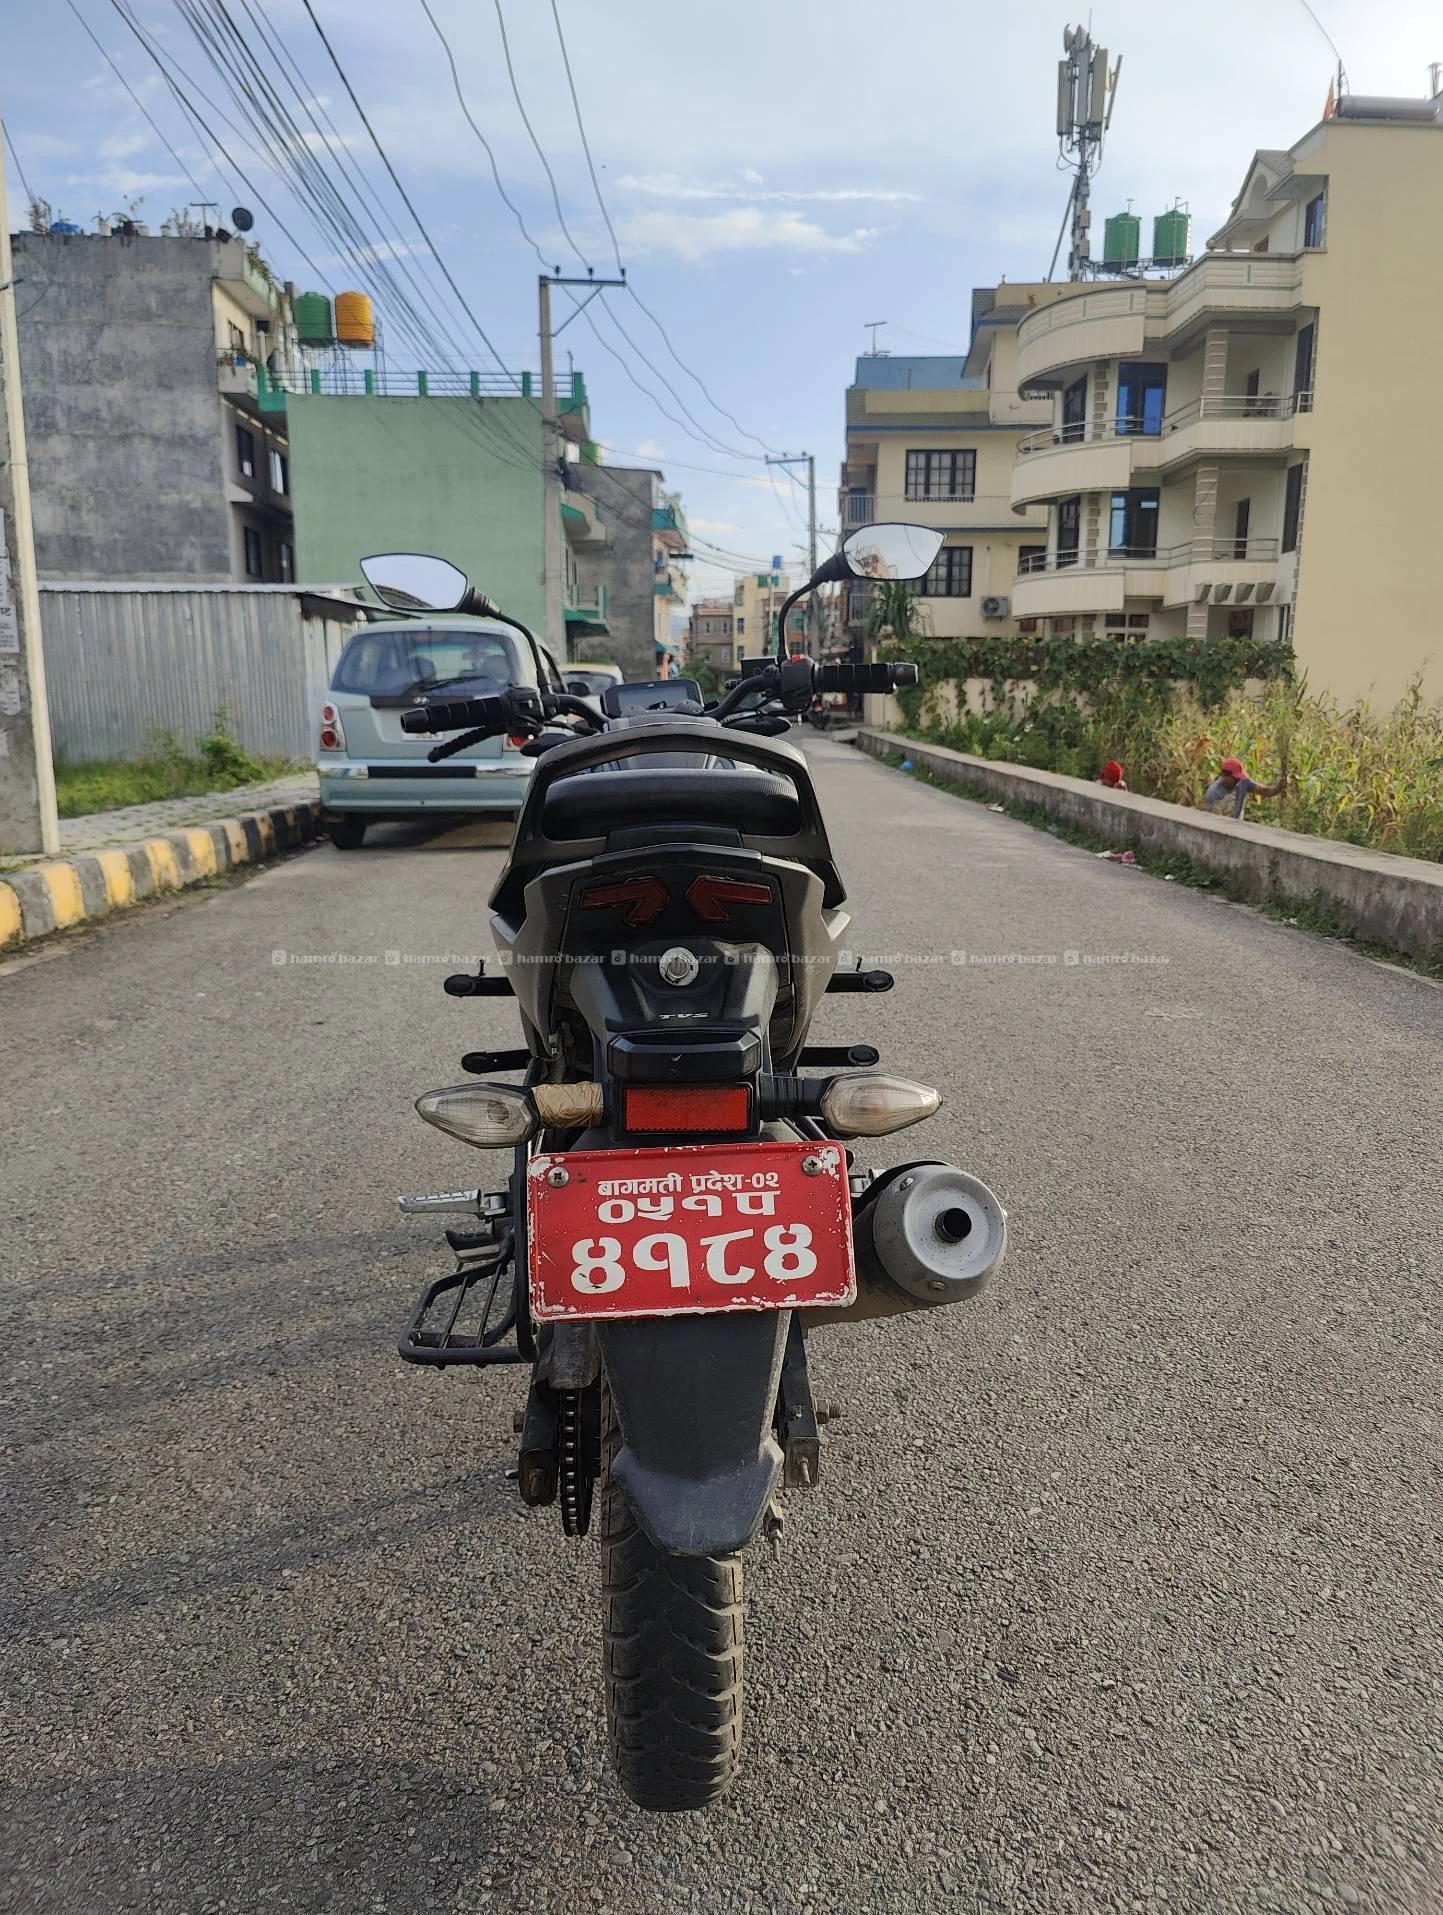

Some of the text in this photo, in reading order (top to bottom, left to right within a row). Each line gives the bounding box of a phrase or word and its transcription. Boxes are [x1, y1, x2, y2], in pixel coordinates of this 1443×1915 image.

[659, 1012, 709, 1020] TVS
[597, 1172, 682, 1196] बागमती
[570, 1223, 818, 1294] ४१८४
